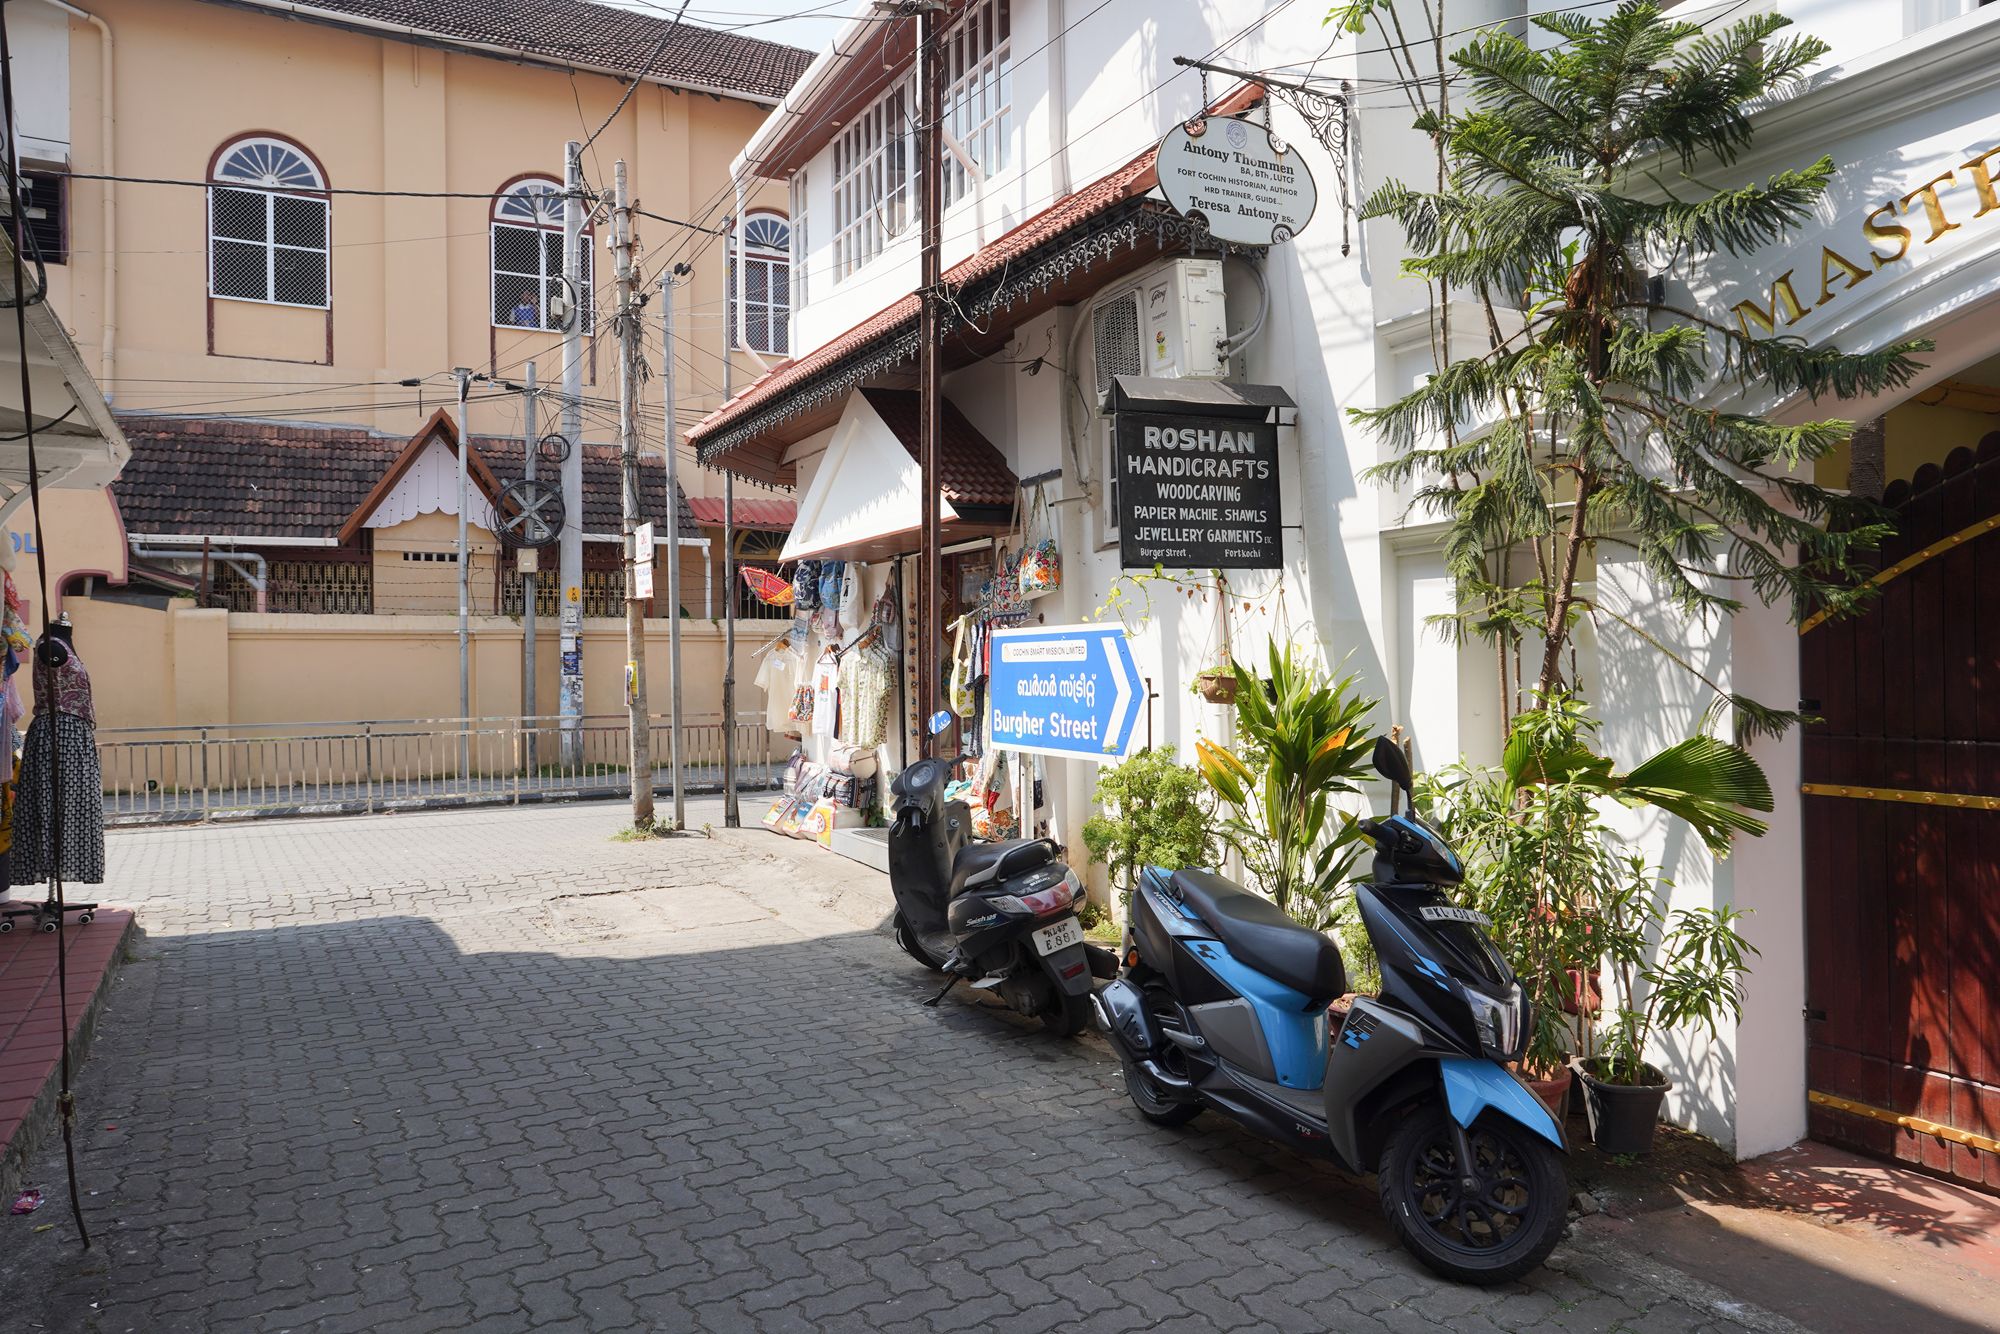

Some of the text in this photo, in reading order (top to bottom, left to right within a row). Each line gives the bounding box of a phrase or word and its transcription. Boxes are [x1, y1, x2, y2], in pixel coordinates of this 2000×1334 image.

[1183, 140, 1295, 175] Antony Thommen
[1177, 168, 1298, 197] FORT COCHIN HISTORIAN, AUTHOR
[1240, 167, 1254, 177] BA,
[1273, 172, 1295, 184] LUTCF
[1204, 186, 1220, 196] HRD
[1221, 189, 1254, 201] TRAINER,
[1189, 196, 1231, 213] Teresa
[1238, 204, 1279, 223] Antony
[1144, 426, 1255, 454] ROSHAN
[1127, 455, 1269, 480] HANDICRAFTS
[1156, 483, 1241, 502] WOODCARVING
[1134, 506, 1176, 521] PAPIER
[1225, 509, 1267, 523] SHAWLS
[1134, 527, 1204, 543] JEWELLERY
[1207, 529, 1263, 544] GARMENTS
[1012, 645, 1085, 657] COCHIN SMART MISSION LIMITED
[994, 709, 1098, 740] Burgher Street
[1295, 1122, 1312, 1136] TVS
